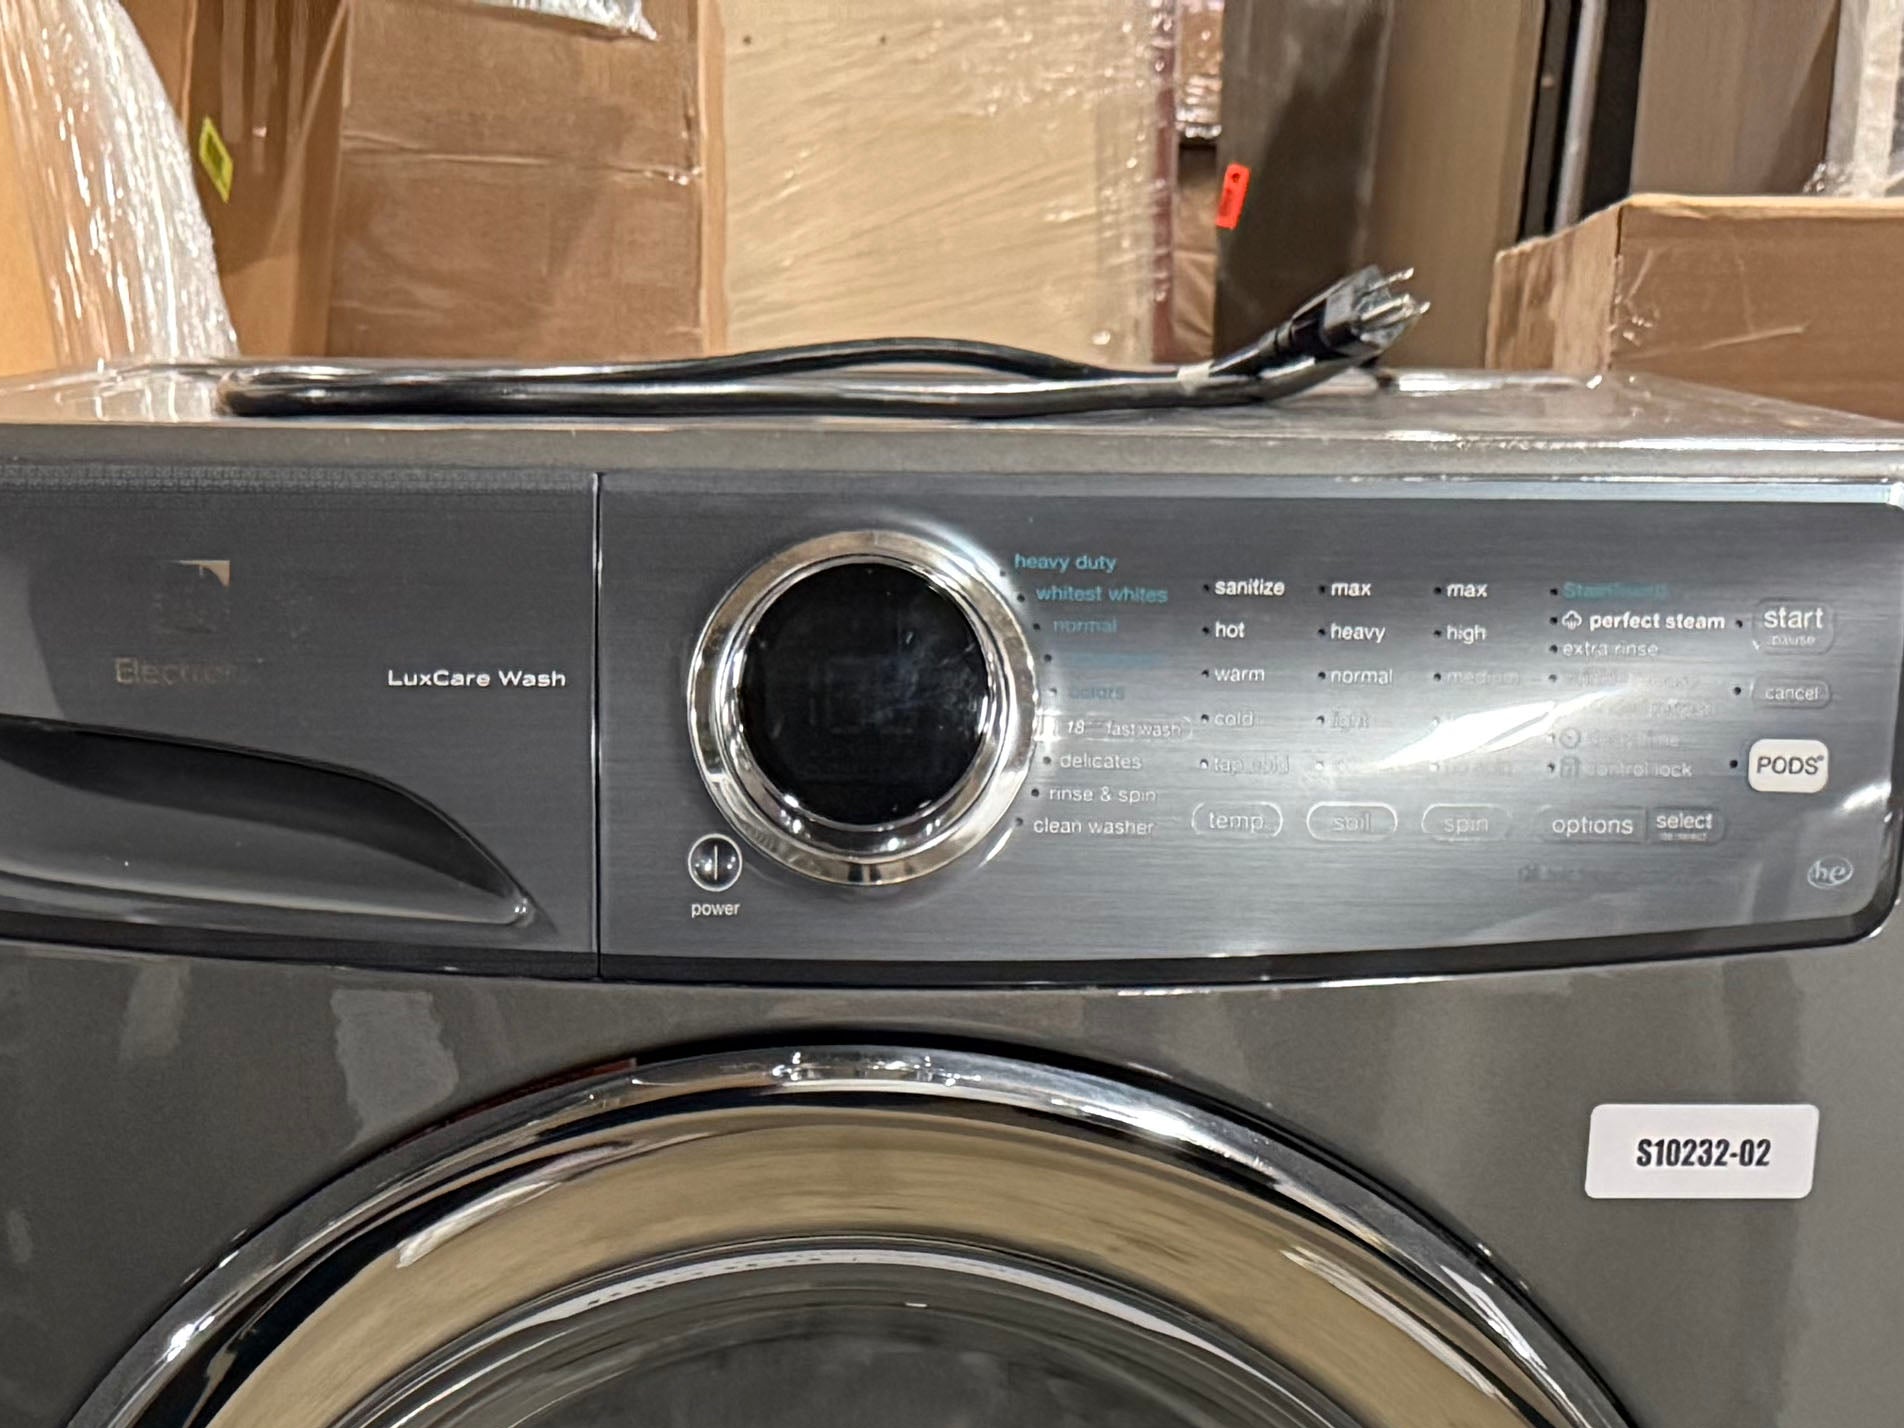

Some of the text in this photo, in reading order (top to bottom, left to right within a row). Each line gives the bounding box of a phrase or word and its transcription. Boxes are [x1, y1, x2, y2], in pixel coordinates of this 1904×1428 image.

[1014, 553, 1117, 574] heavy duty
[1036, 585, 1168, 603] whitest whites
[1215, 578, 1285, 596] sanitize
[1331, 581, 1371, 597] max
[1447, 581, 1488, 598] max
[1053, 617, 1118, 633] normal
[1589, 610, 1725, 632] perfect steam
[1763, 606, 1824, 629] start
[1215, 621, 1245, 638] hot
[1331, 622, 1386, 643] heavy
[1447, 624, 1487, 645] high
[1562, 640, 1658, 656] extra rinse
[388, 669, 566, 688] LuxCare Wash
[1215, 669, 1265, 682] warm
[1331, 669, 1393, 685] normal
[1765, 686, 1820, 701] cancel
[1214, 711, 1254, 726] cold
[1060, 752, 1142, 769] delicates
[1656, 761, 1693, 777] lock
[1049, 785, 1156, 805] rinse & spin
[1033, 817, 1154, 835] clean washer
[1209, 812, 1264, 833] temp
[1332, 814, 1372, 832] soil
[1444, 818, 1488, 838] spin
[1552, 816, 1634, 836] options
[1656, 812, 1712, 829] select
[691, 903, 740, 918] power
[1636, 1138, 1772, 1167] S10232-02
